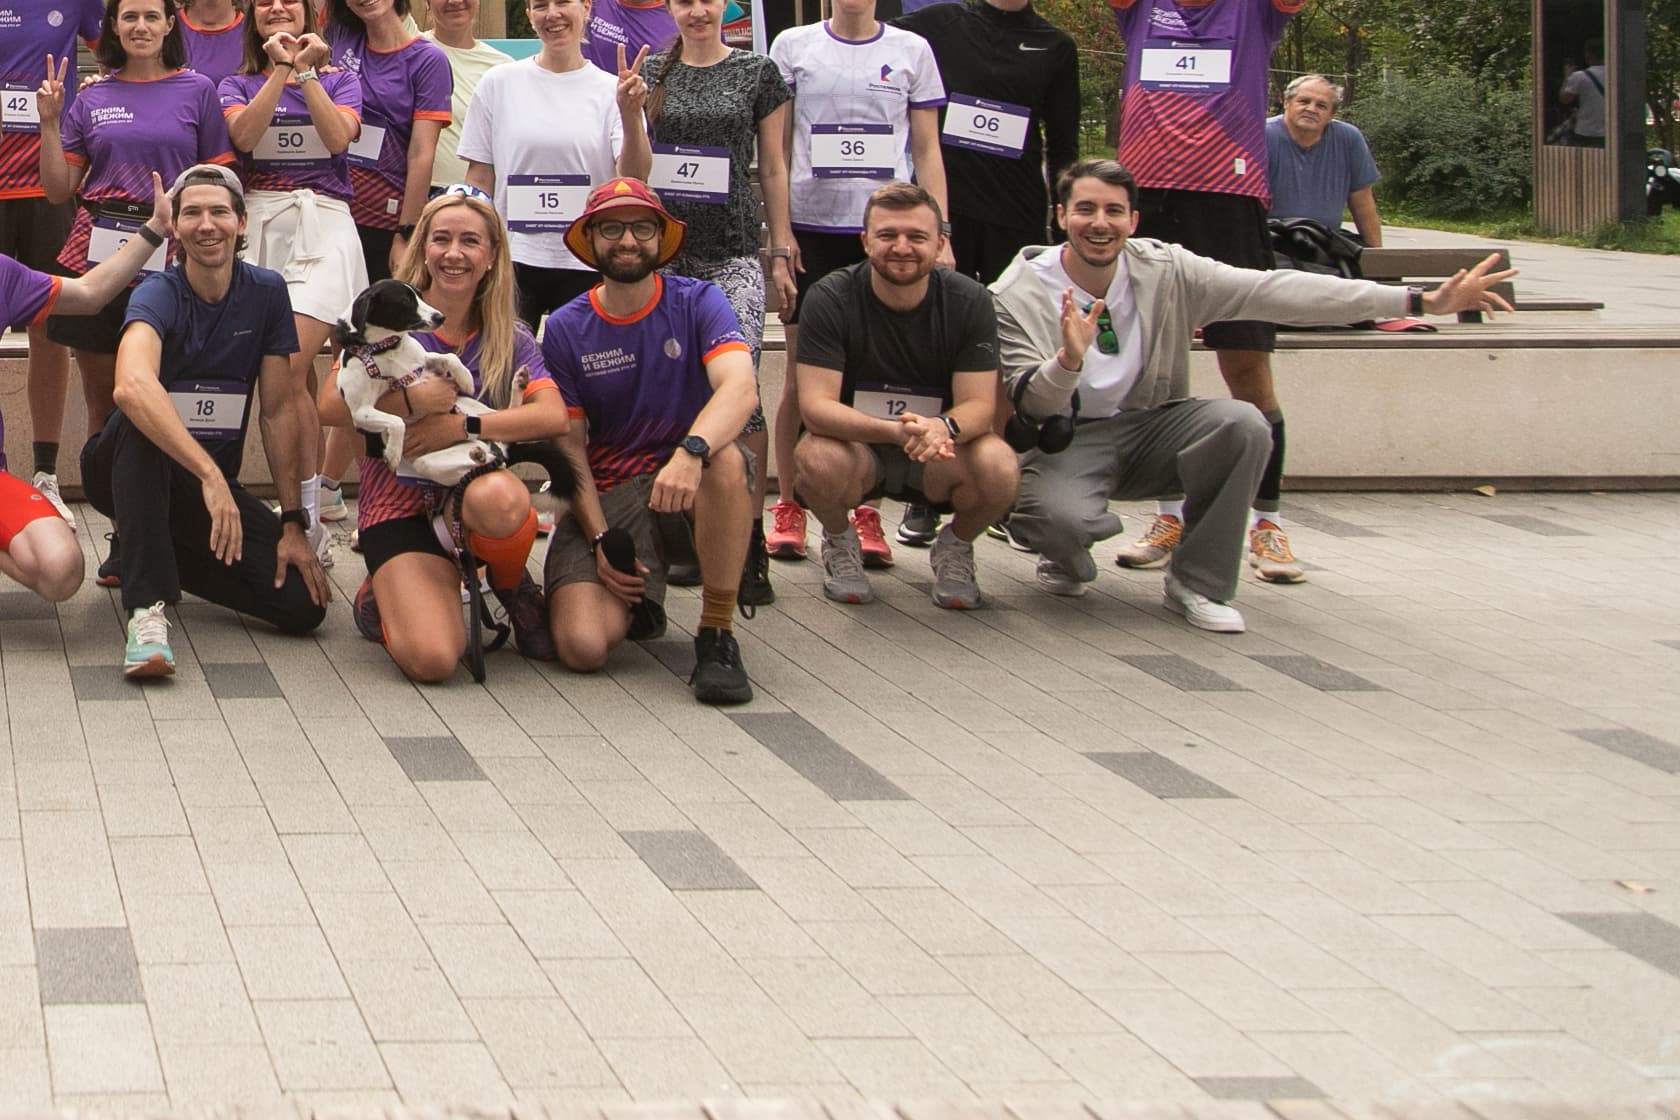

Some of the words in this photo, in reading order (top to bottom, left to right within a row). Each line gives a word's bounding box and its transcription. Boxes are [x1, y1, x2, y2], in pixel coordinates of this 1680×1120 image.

[1175, 55, 1196, 70] 41
[7, 97, 28, 112] 42
[973, 114, 1000, 132] 06
[277, 132, 304, 148] 50
[840, 140, 865, 156] 36
[676, 162, 700, 178] 47
[538, 192, 559, 208] 15
[581, 347, 624, 364] БЕЖИМ
[592, 353, 636, 370] БЕЖИМ
[195, 399, 215, 416] 18
[886, 399, 907, 416] 12
